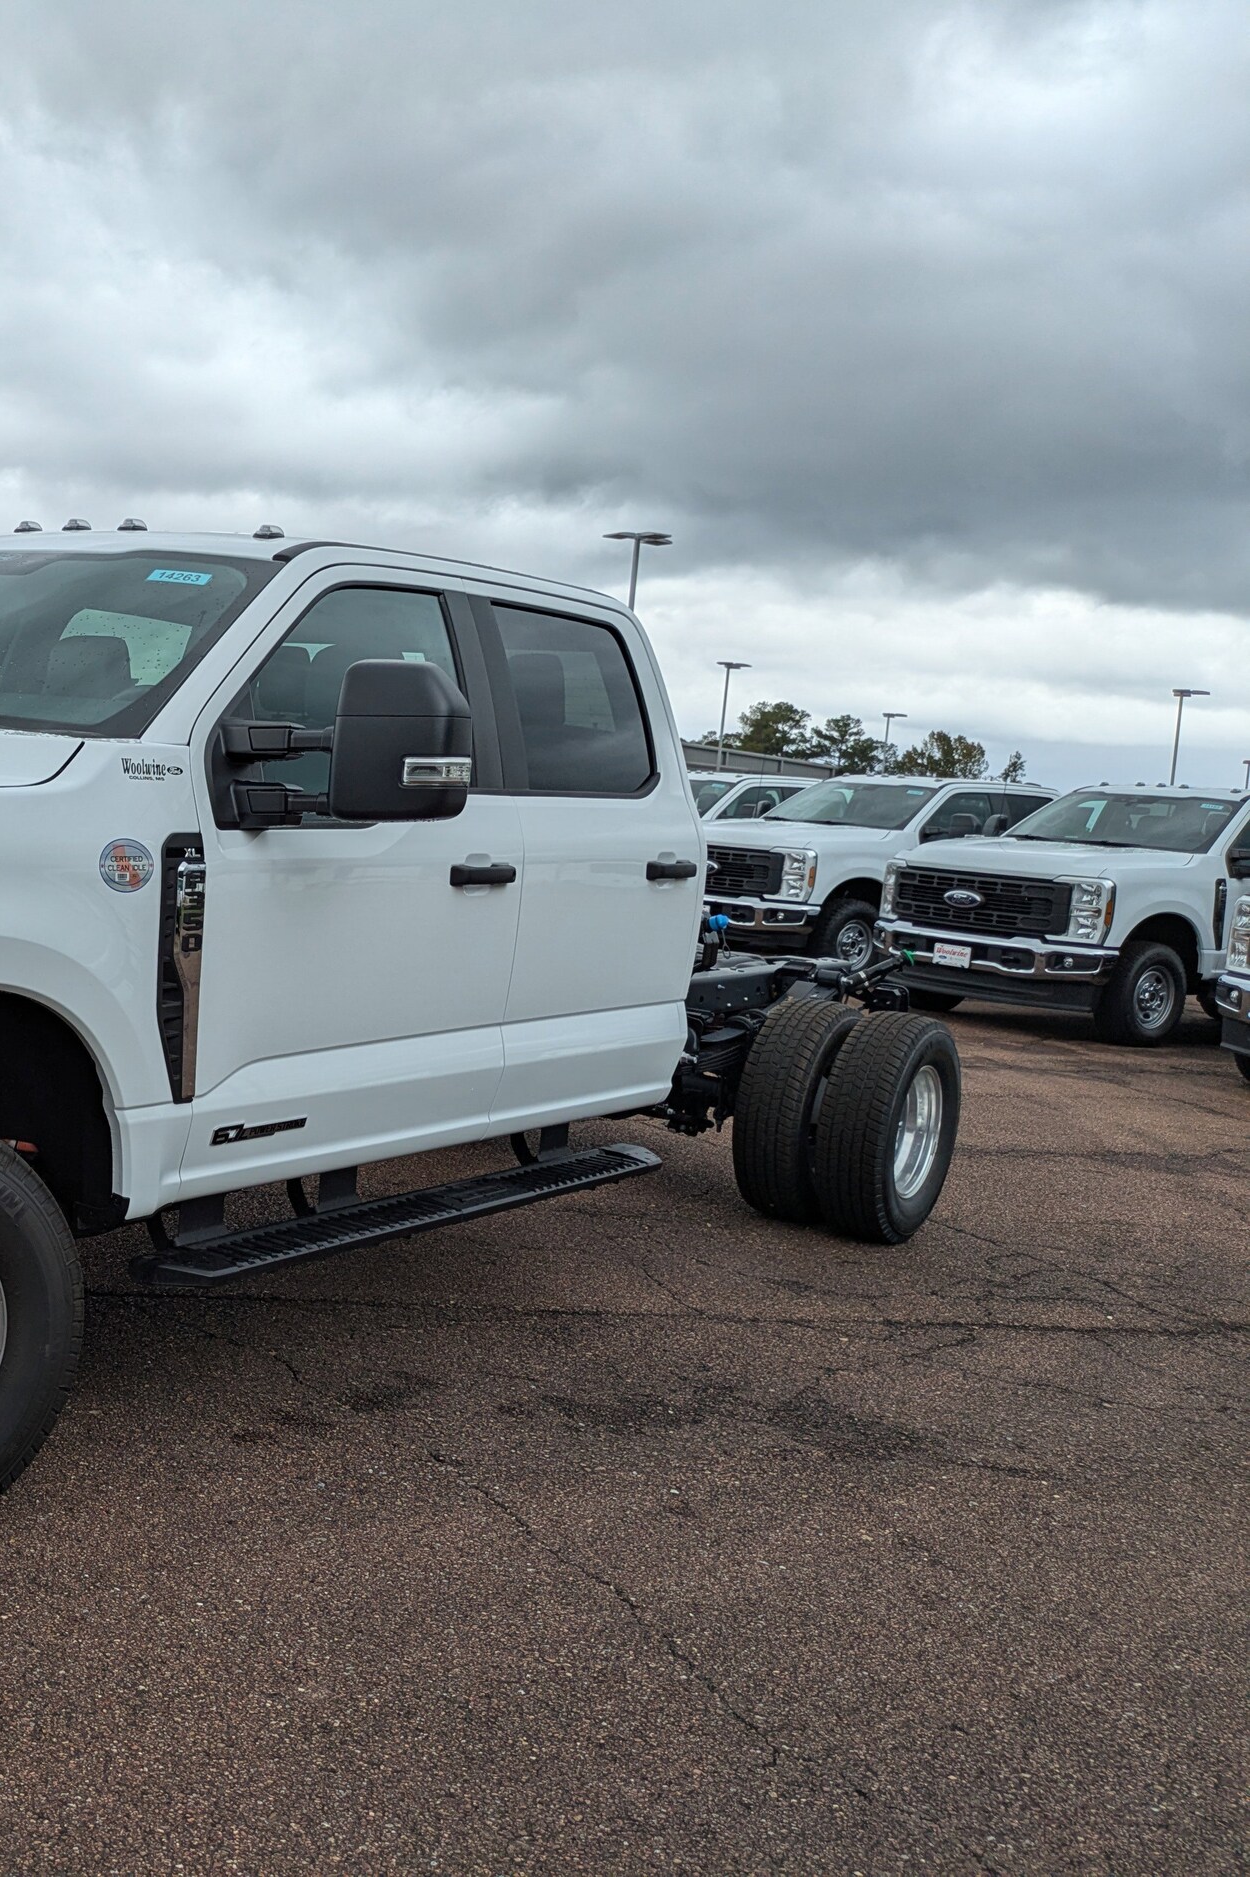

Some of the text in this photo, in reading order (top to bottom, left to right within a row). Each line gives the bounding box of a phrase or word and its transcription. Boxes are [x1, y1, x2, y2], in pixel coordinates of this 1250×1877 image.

[158, 571, 202, 582] 14263
[121, 758, 167, 776] Woolwine
[183, 847, 201, 858] XL
[107, 864, 130, 872] CLEAN
